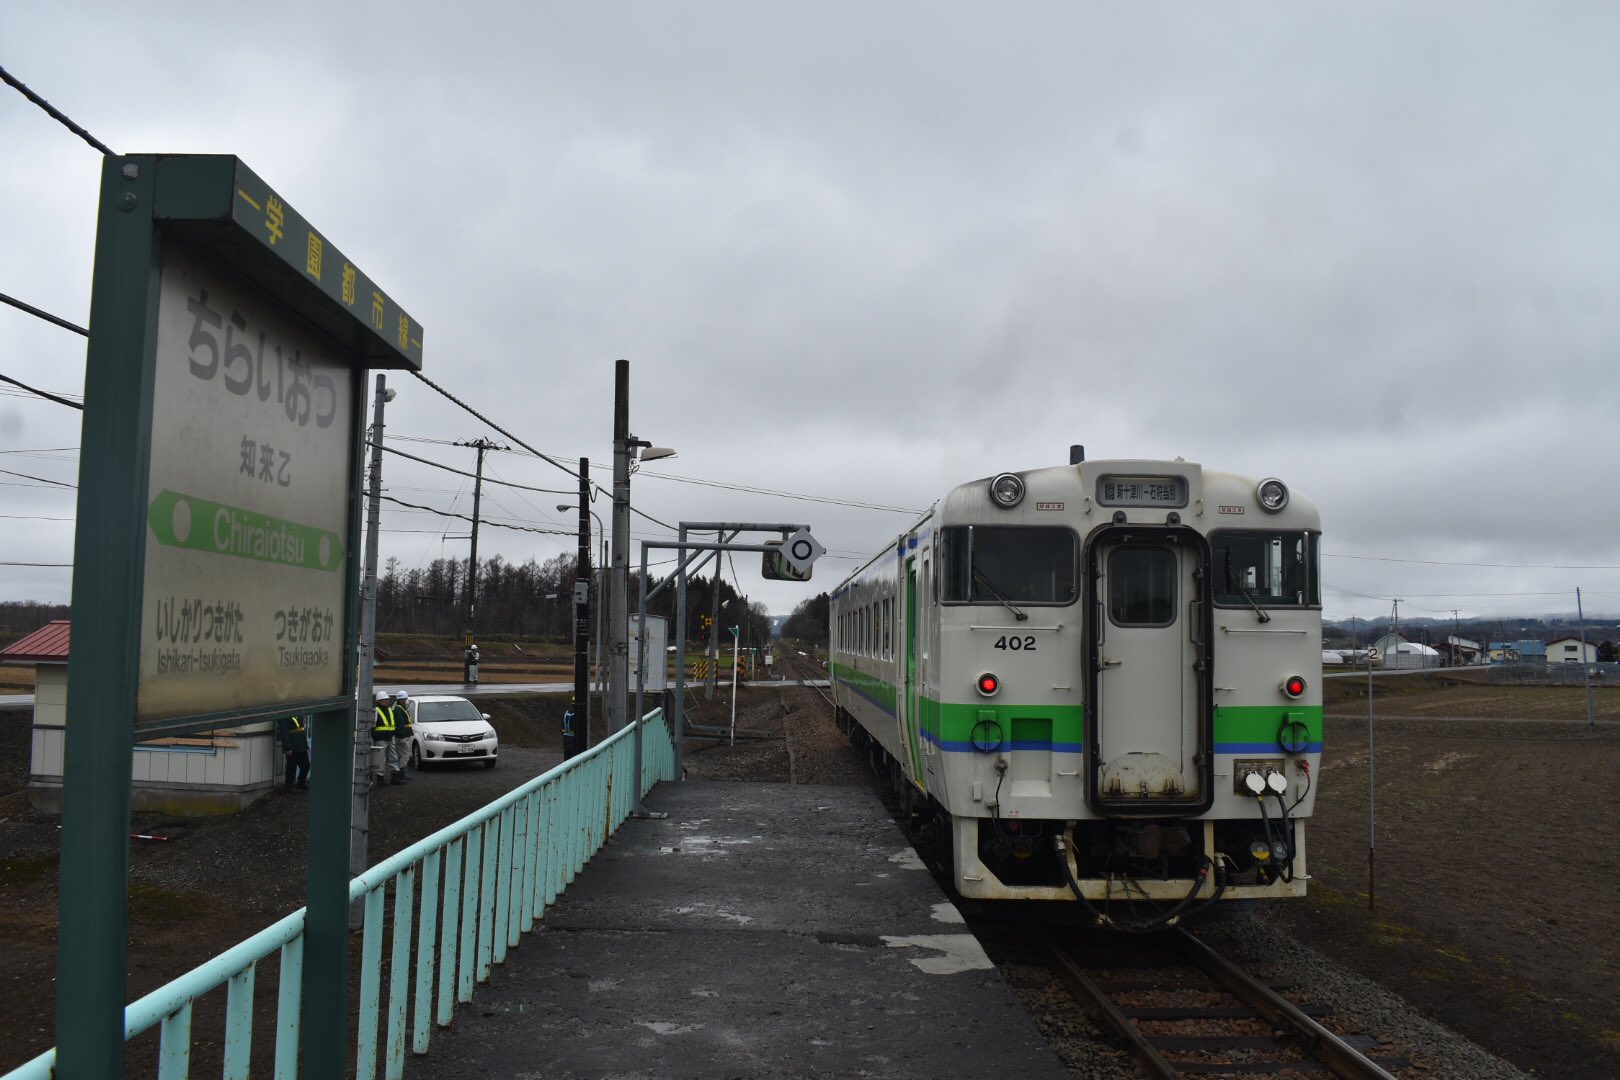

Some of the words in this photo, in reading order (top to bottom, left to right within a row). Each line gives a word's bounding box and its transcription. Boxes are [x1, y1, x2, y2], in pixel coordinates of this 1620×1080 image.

[187, 288, 337, 428] ちらいおつ
[239, 434, 290, 487] 知来乙
[213, 507, 305, 564] Chiraiotsu
[157, 596, 244, 643] いしかりつきがた
[274, 605, 333, 643] つきがおか
[157, 648, 240, 676] Ishikari-tsukigata
[278, 647, 329, 669] Tsukigaoka
[994, 635, 1036, 651] 402
[1369, 648, 1378, 659] 2
